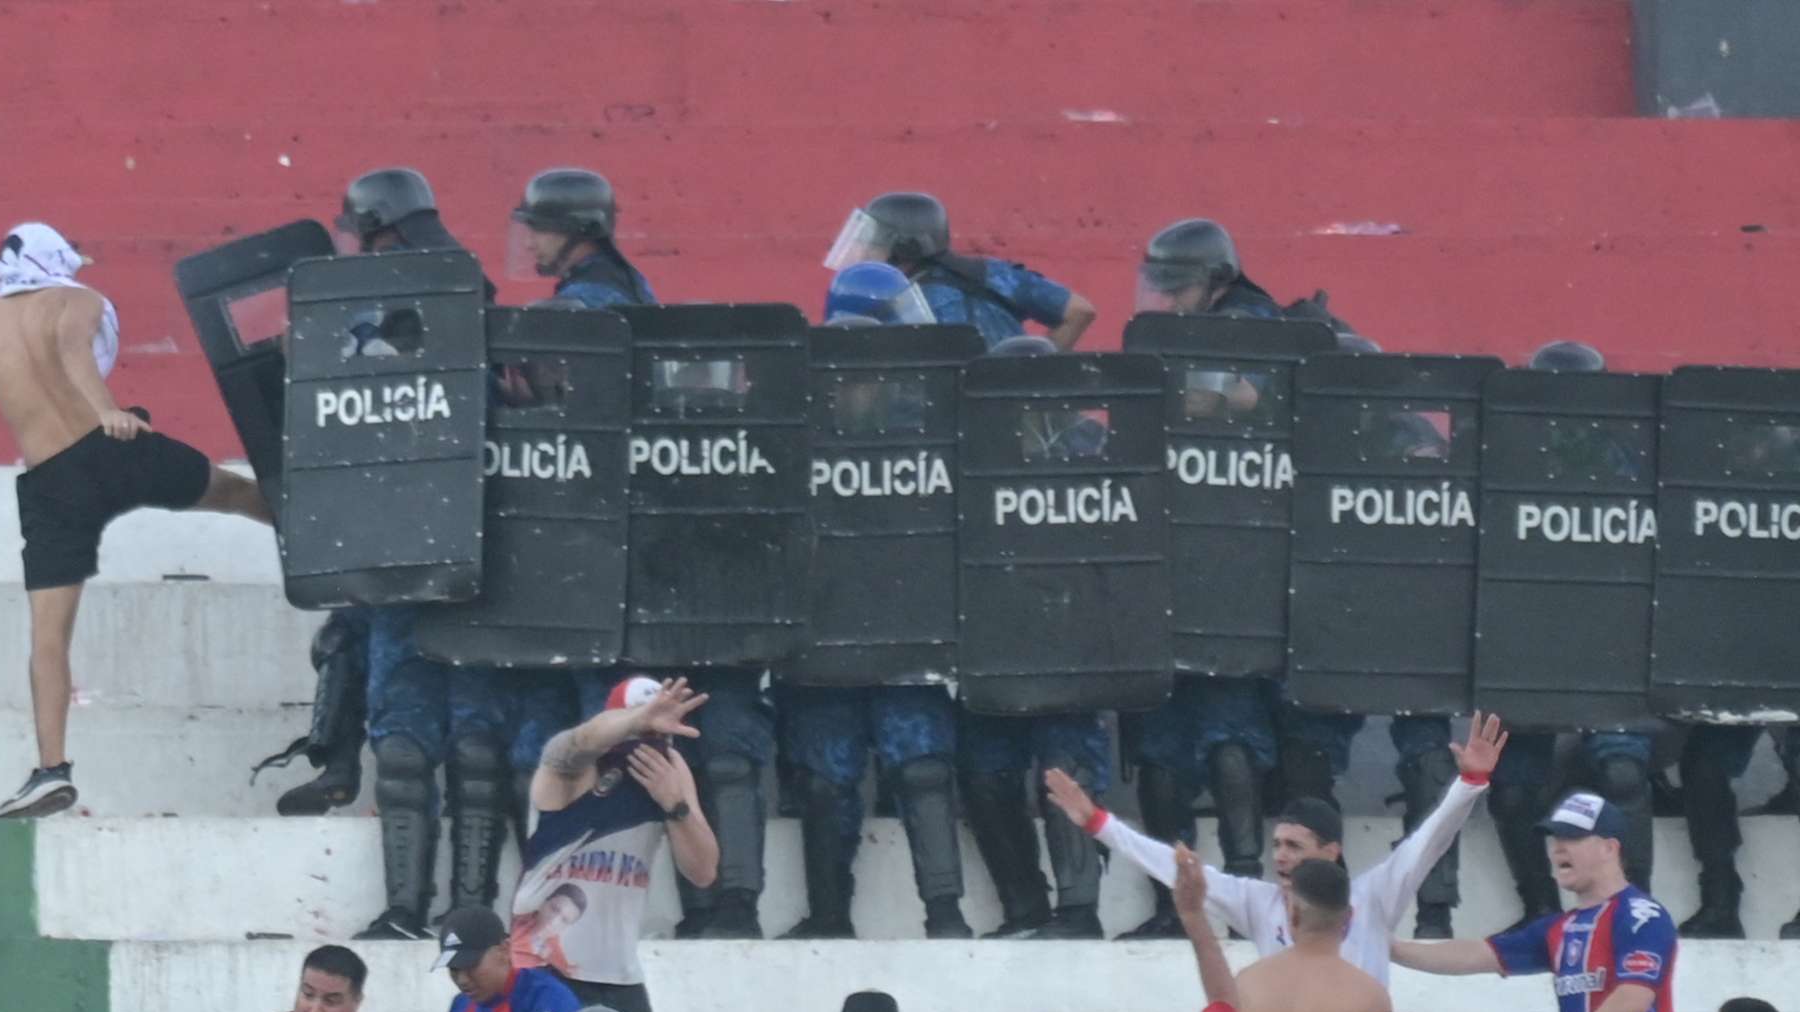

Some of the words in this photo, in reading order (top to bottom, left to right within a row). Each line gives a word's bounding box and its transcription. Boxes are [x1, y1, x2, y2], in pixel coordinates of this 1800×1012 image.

[316, 375, 450, 427] POLICÍA
[485, 434, 592, 479] OLICÍA
[809, 451, 953, 497] POLICÍA
[995, 479, 1138, 525] POLICÍA
[1330, 481, 1476, 526] POLICÍA
[1517, 500, 1658, 543] POLICÍA
[1694, 500, 1800, 540] POLIC
